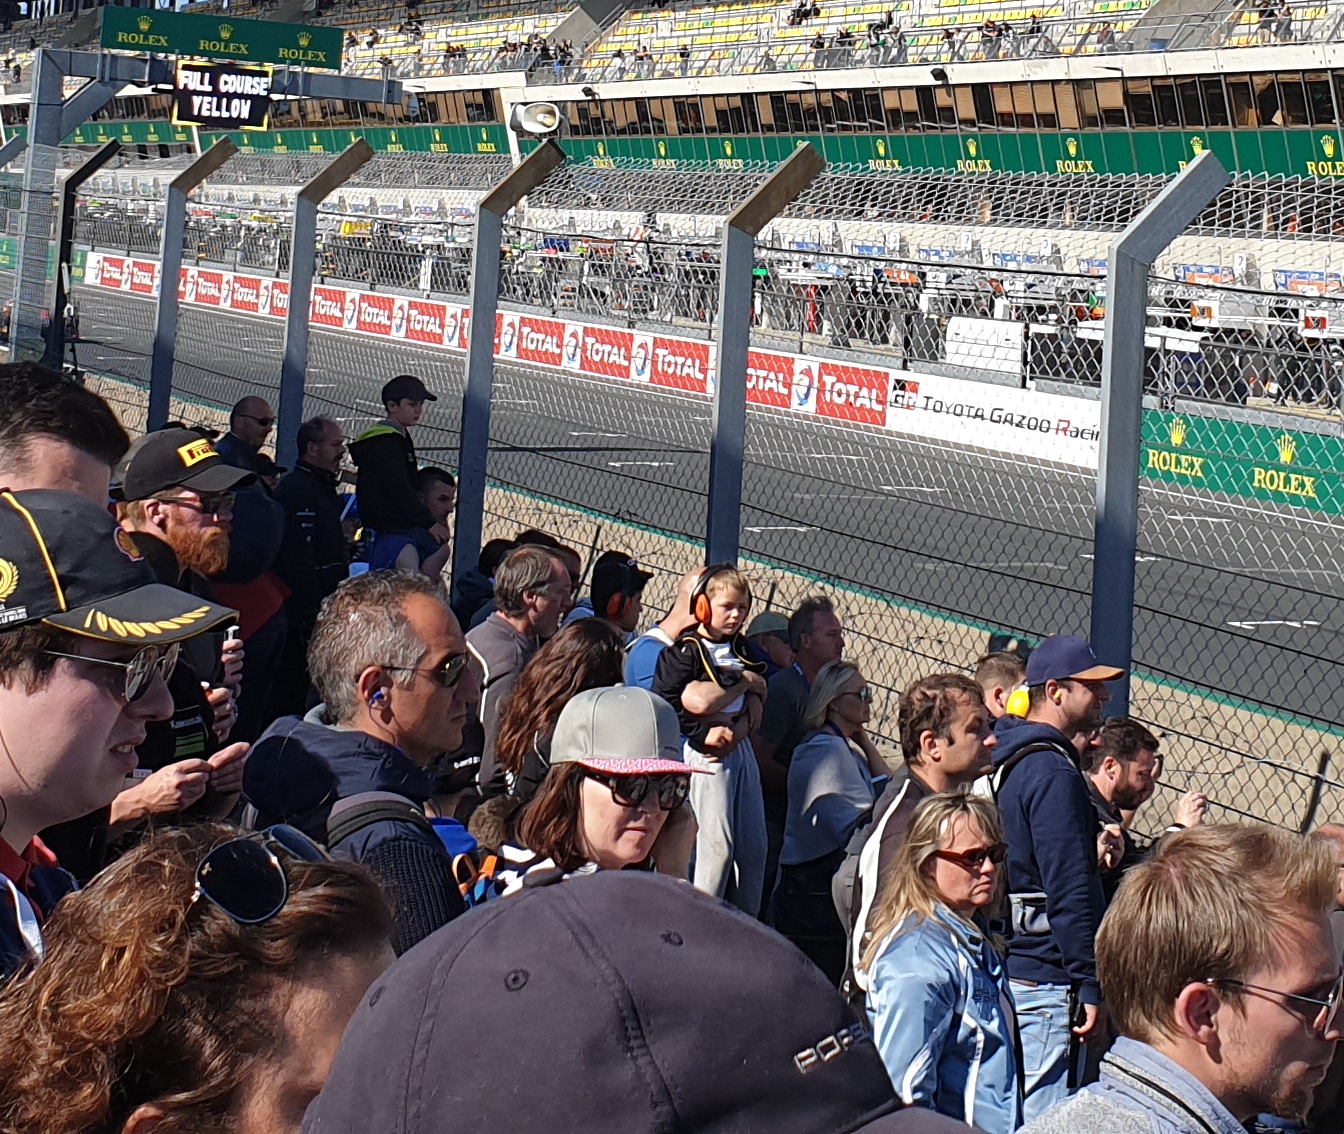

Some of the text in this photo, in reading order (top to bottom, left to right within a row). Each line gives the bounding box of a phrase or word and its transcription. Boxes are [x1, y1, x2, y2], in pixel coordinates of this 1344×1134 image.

[117, 31, 169, 47] ROLEX
[199, 39, 249, 55] ROLEX
[278, 47, 327, 63] ROLEX
[178, 71, 269, 96] FULL COURSE
[191, 95, 252, 120] YELLOW
[957, 159, 992, 172] ROLEX
[1056, 160, 1094, 173] ROLEX
[197, 277, 221, 297] TOTAL
[234, 283, 259, 303] TOTAL
[314, 296, 343, 318] TOTAL
[360, 302, 391, 326] TOTAL
[409, 310, 443, 334] TOTAL
[521, 327, 561, 354] TOTAL
[584, 336, 630, 367] TOTAL
[656, 348, 704, 380] TOTAL
[824, 376, 885, 412] TOTAL
[923, 396, 984, 421] TOYOTA
[1147, 449, 1205, 477] ROLEX
[1253, 467, 1316, 498] ROLEX
